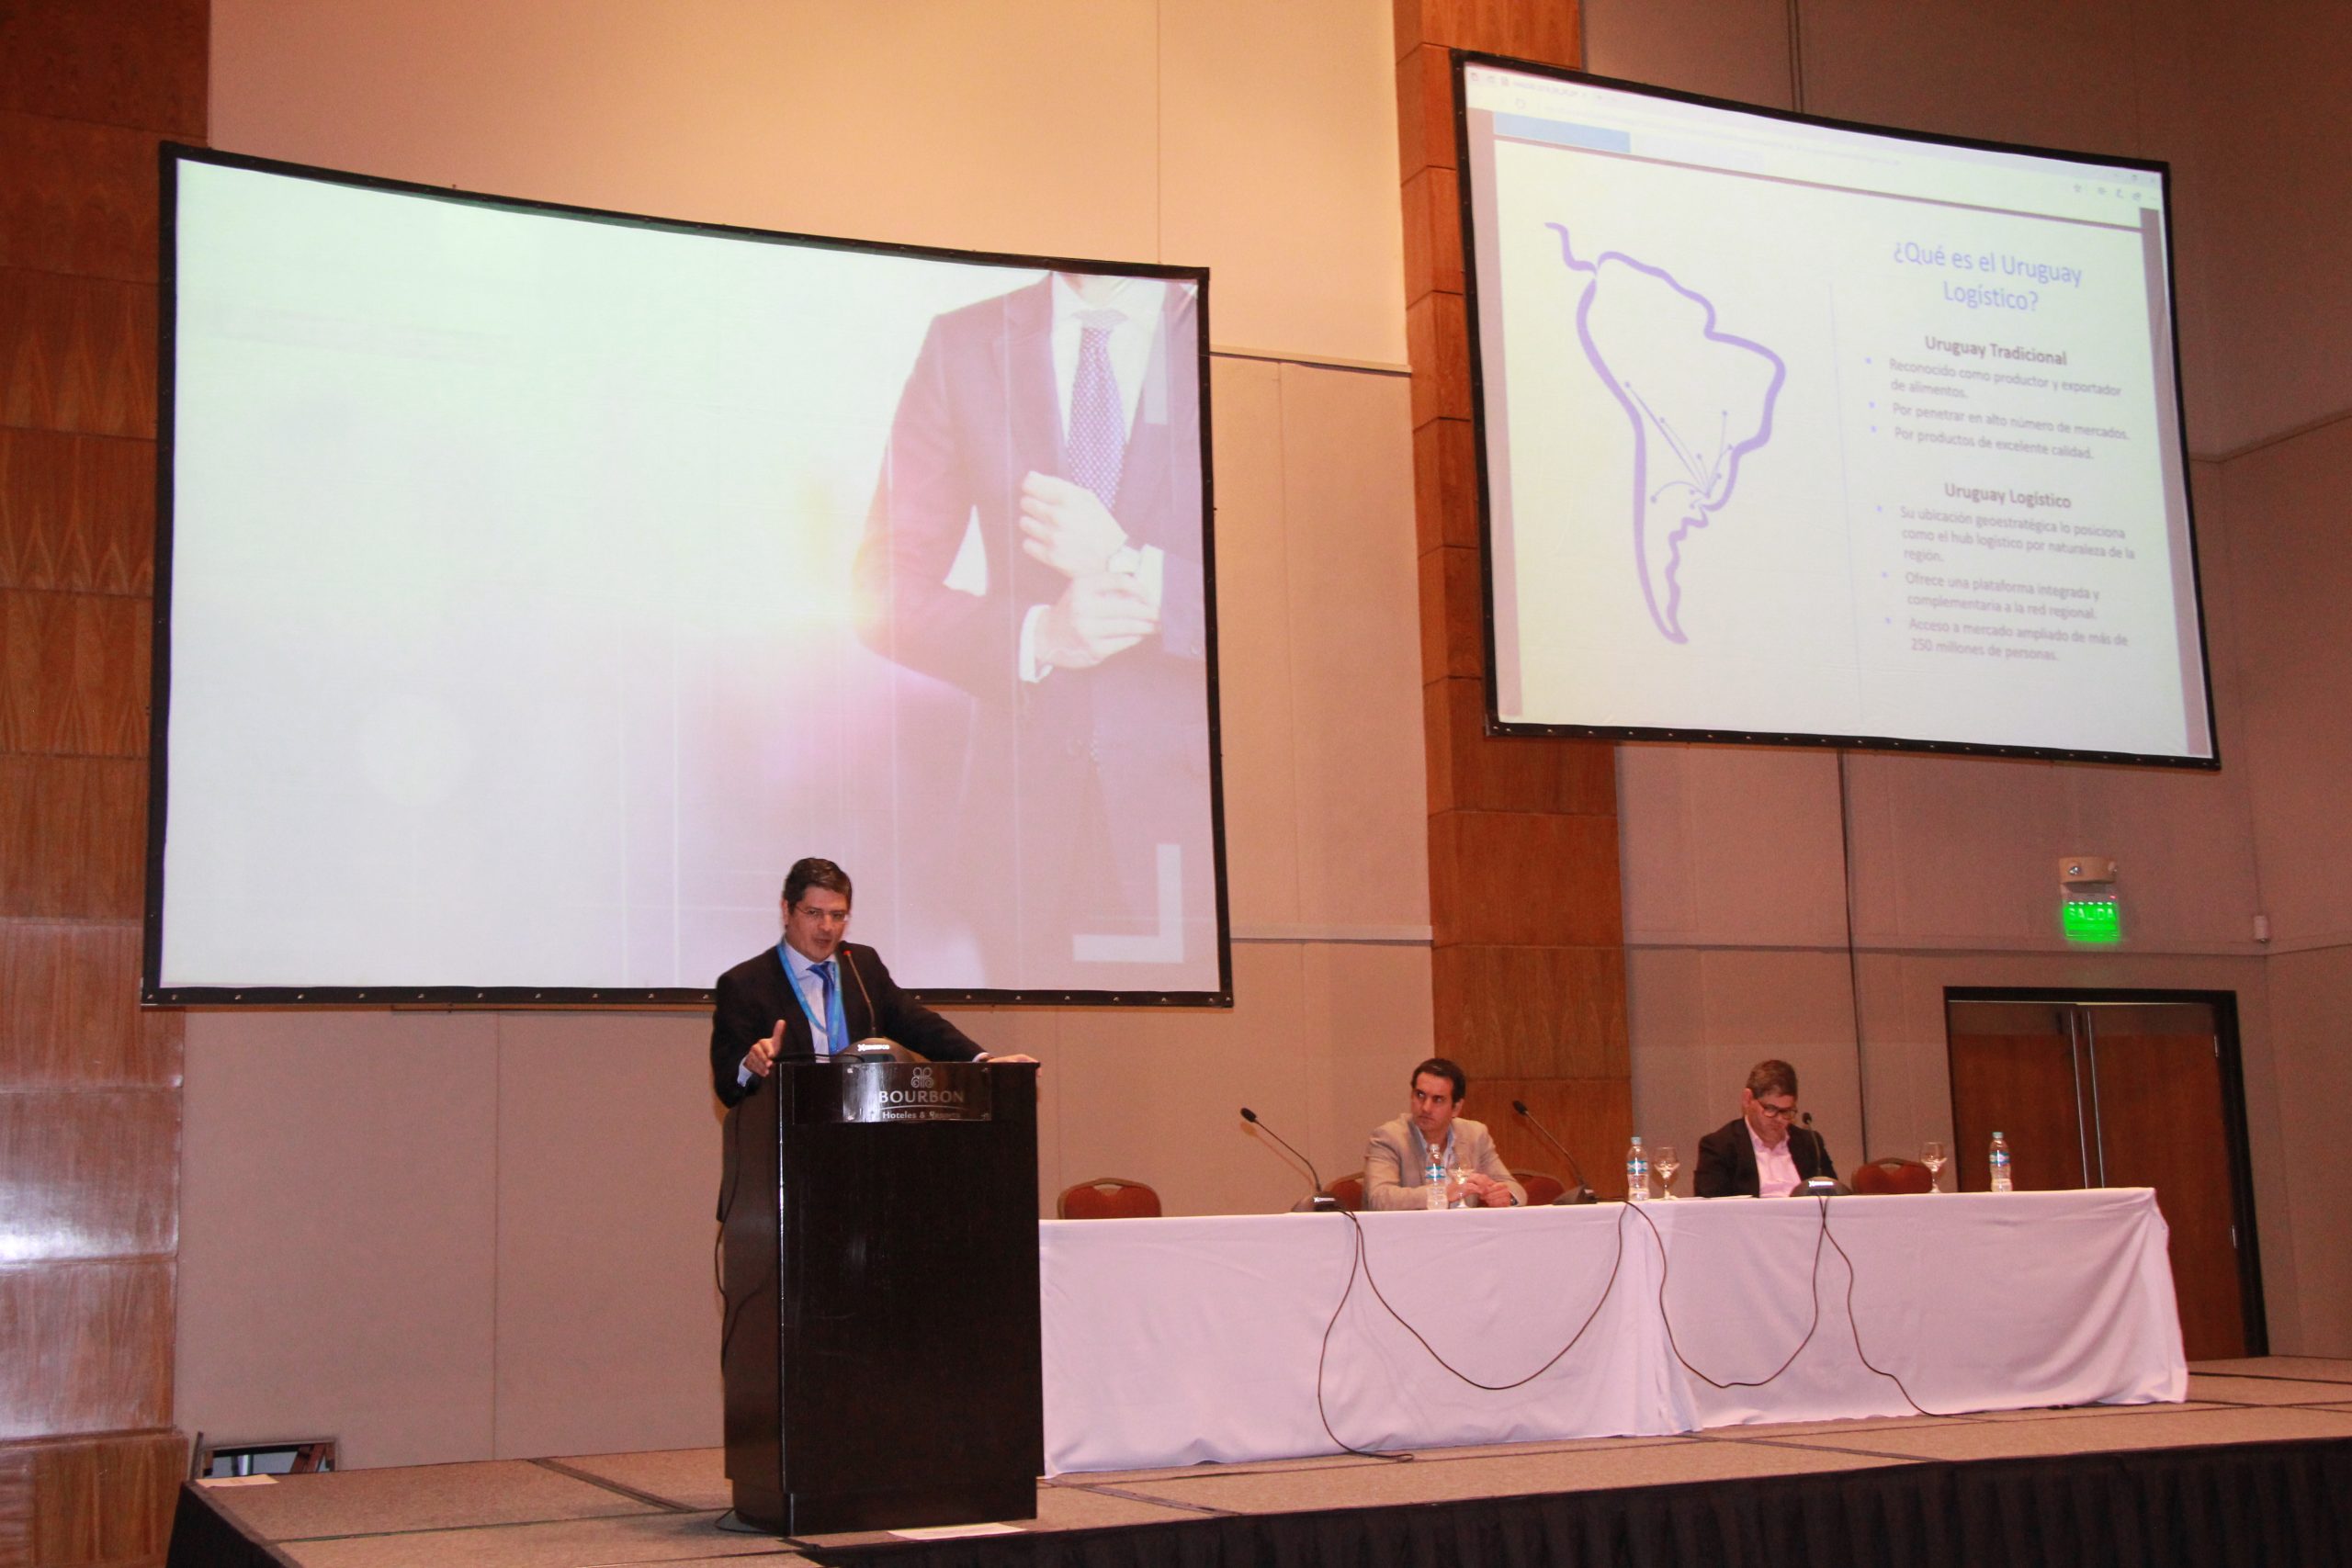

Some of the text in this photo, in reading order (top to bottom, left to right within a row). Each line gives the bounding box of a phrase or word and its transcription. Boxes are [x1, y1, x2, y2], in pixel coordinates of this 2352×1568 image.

[1894, 241, 2083, 288] ¿Qué es el Uruguay
[1943, 281, 2040, 311] Logístico?
[1925, 335, 2067, 366] Uruguay Tradicional
[1889, 358, 2122, 397] Reconocido como productor y exportador
[1891, 378, 1969, 399] de alimentos.
[1893, 402, 2131, 441] Por penetrar en alto número de mercados.
[1894, 426, 2094, 459] Por productos de excelente calidad.
[1944, 482, 2072, 509] Uruguay Logístico
[1900, 505, 2126, 540] Su ubicación geoestratégica lo posiciona
[1902, 529, 2136, 559] como el hub logístico por naturaleza de la
[1904, 548, 1944, 563] región.
[1905, 571, 2100, 603] Ofrece una plataforma integrada y
[1907, 592, 2098, 620] complementaria a la red regional.
[1909, 617, 2129, 646] Acceso a mercado ampliado de más de
[1911, 637, 2059, 660] 250 millones de personas.
[878, 1090, 965, 1103] BOURBON
[882, 1111, 917, 1119] Hoteles
